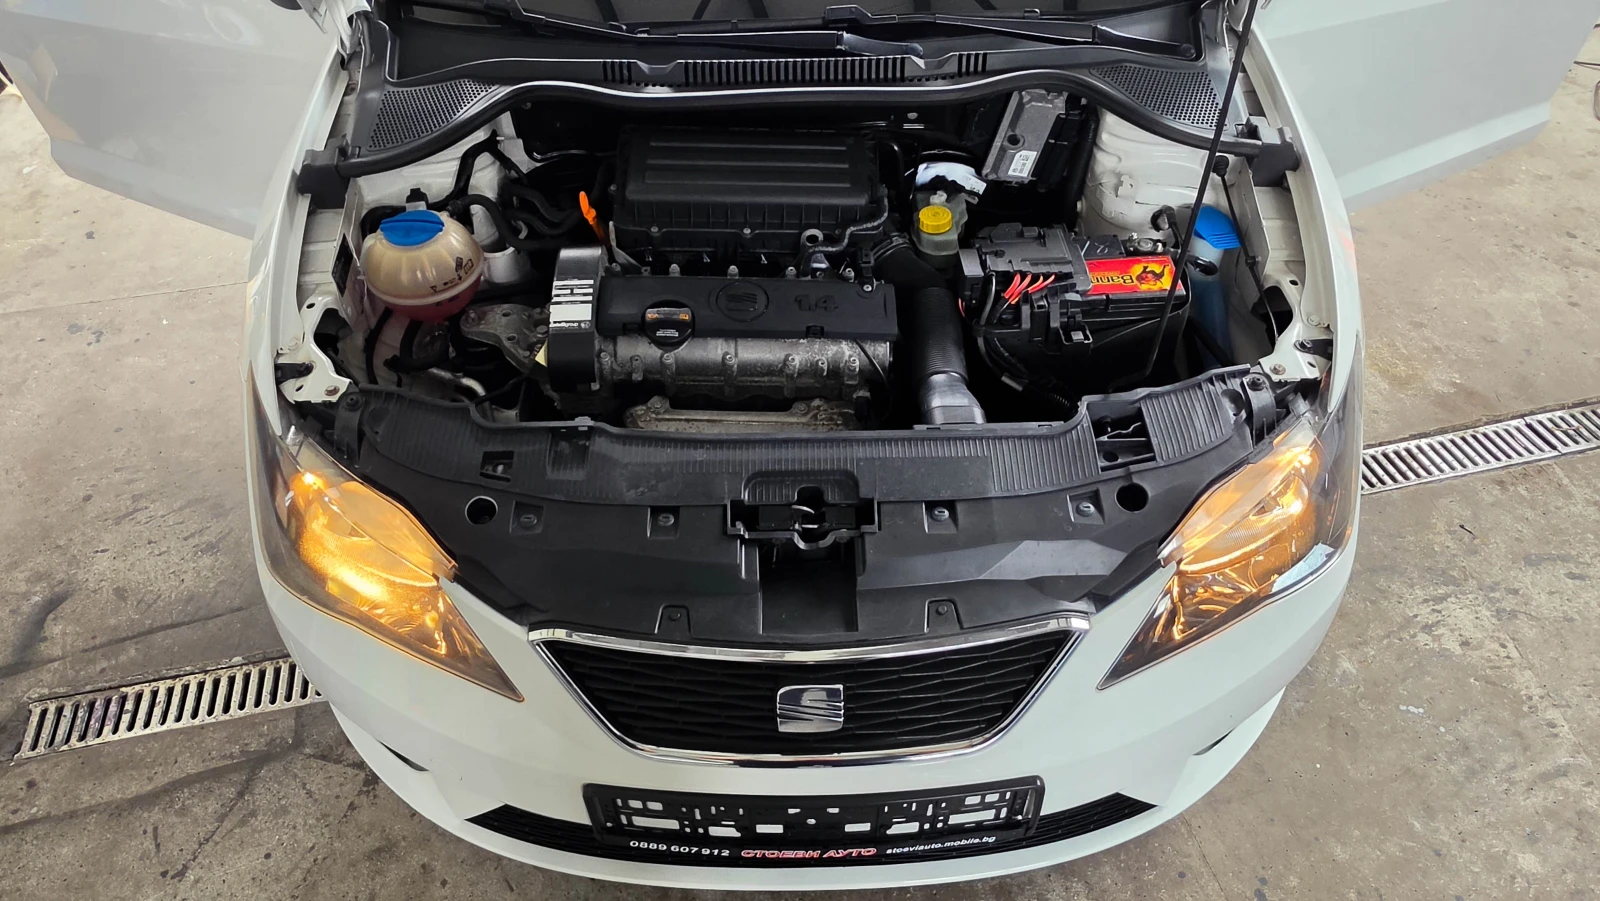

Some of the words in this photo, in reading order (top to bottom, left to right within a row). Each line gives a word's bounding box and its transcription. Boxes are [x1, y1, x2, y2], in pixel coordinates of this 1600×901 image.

[629, 840, 667, 851] 0889
[670, 845, 699, 853] 607
[701, 848, 730, 856] 912
[741, 849, 821, 858] СТОЕВИ
[822, 847, 877, 858] АУТО
[886, 836, 996, 854] stoeviauto.mobile.bg
